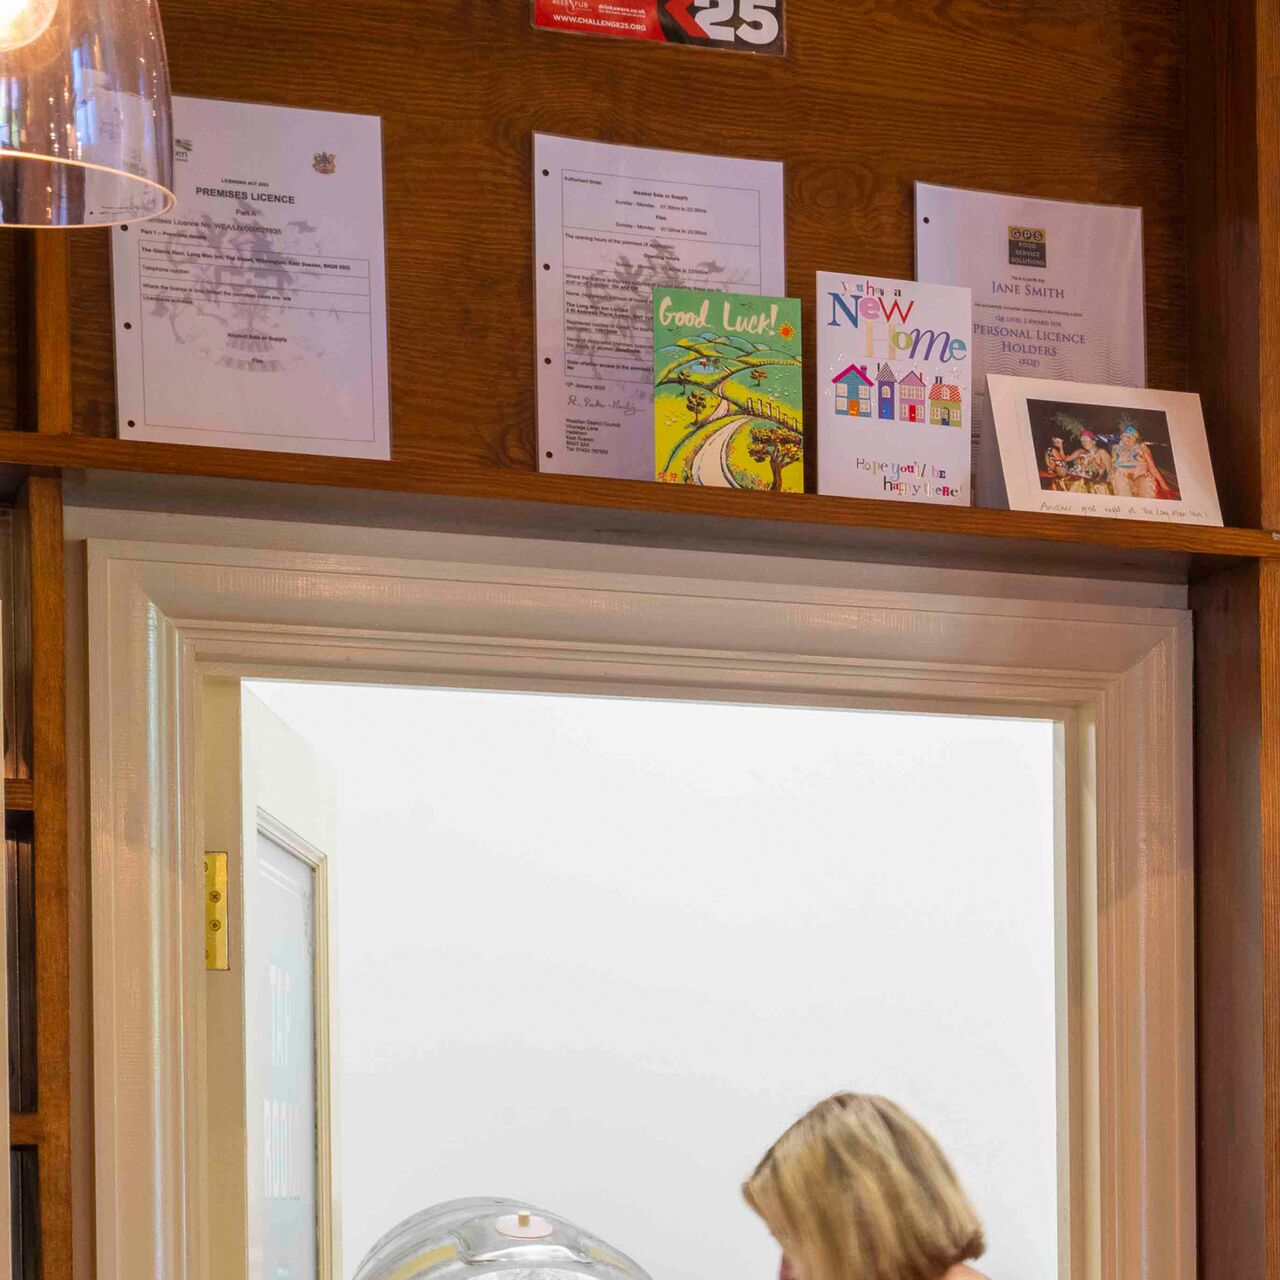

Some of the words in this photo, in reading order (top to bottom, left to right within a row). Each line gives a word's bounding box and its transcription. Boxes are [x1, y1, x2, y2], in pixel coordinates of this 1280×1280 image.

[553, 14, 647, 32] WWW.CHALLENGE25.ORG
[694, 0, 780, 45] 25
[196, 186, 248, 200] PREMISES
[250, 192, 295, 205] LICENCE
[1011, 228, 1043, 241] GPS
[992, 281, 1021, 295] JANE
[1024, 284, 1065, 299] SMITH
[659, 296, 711, 327] Good
[722, 301, 778, 336] Luck!
[973, 323, 1032, 341] PERSONAL
[1036, 329, 1086, 345] LICENCE
[1002, 341, 1058, 357] HOLDERS
[856, 457, 889, 475] Hope
[883, 475, 921, 496] happy
